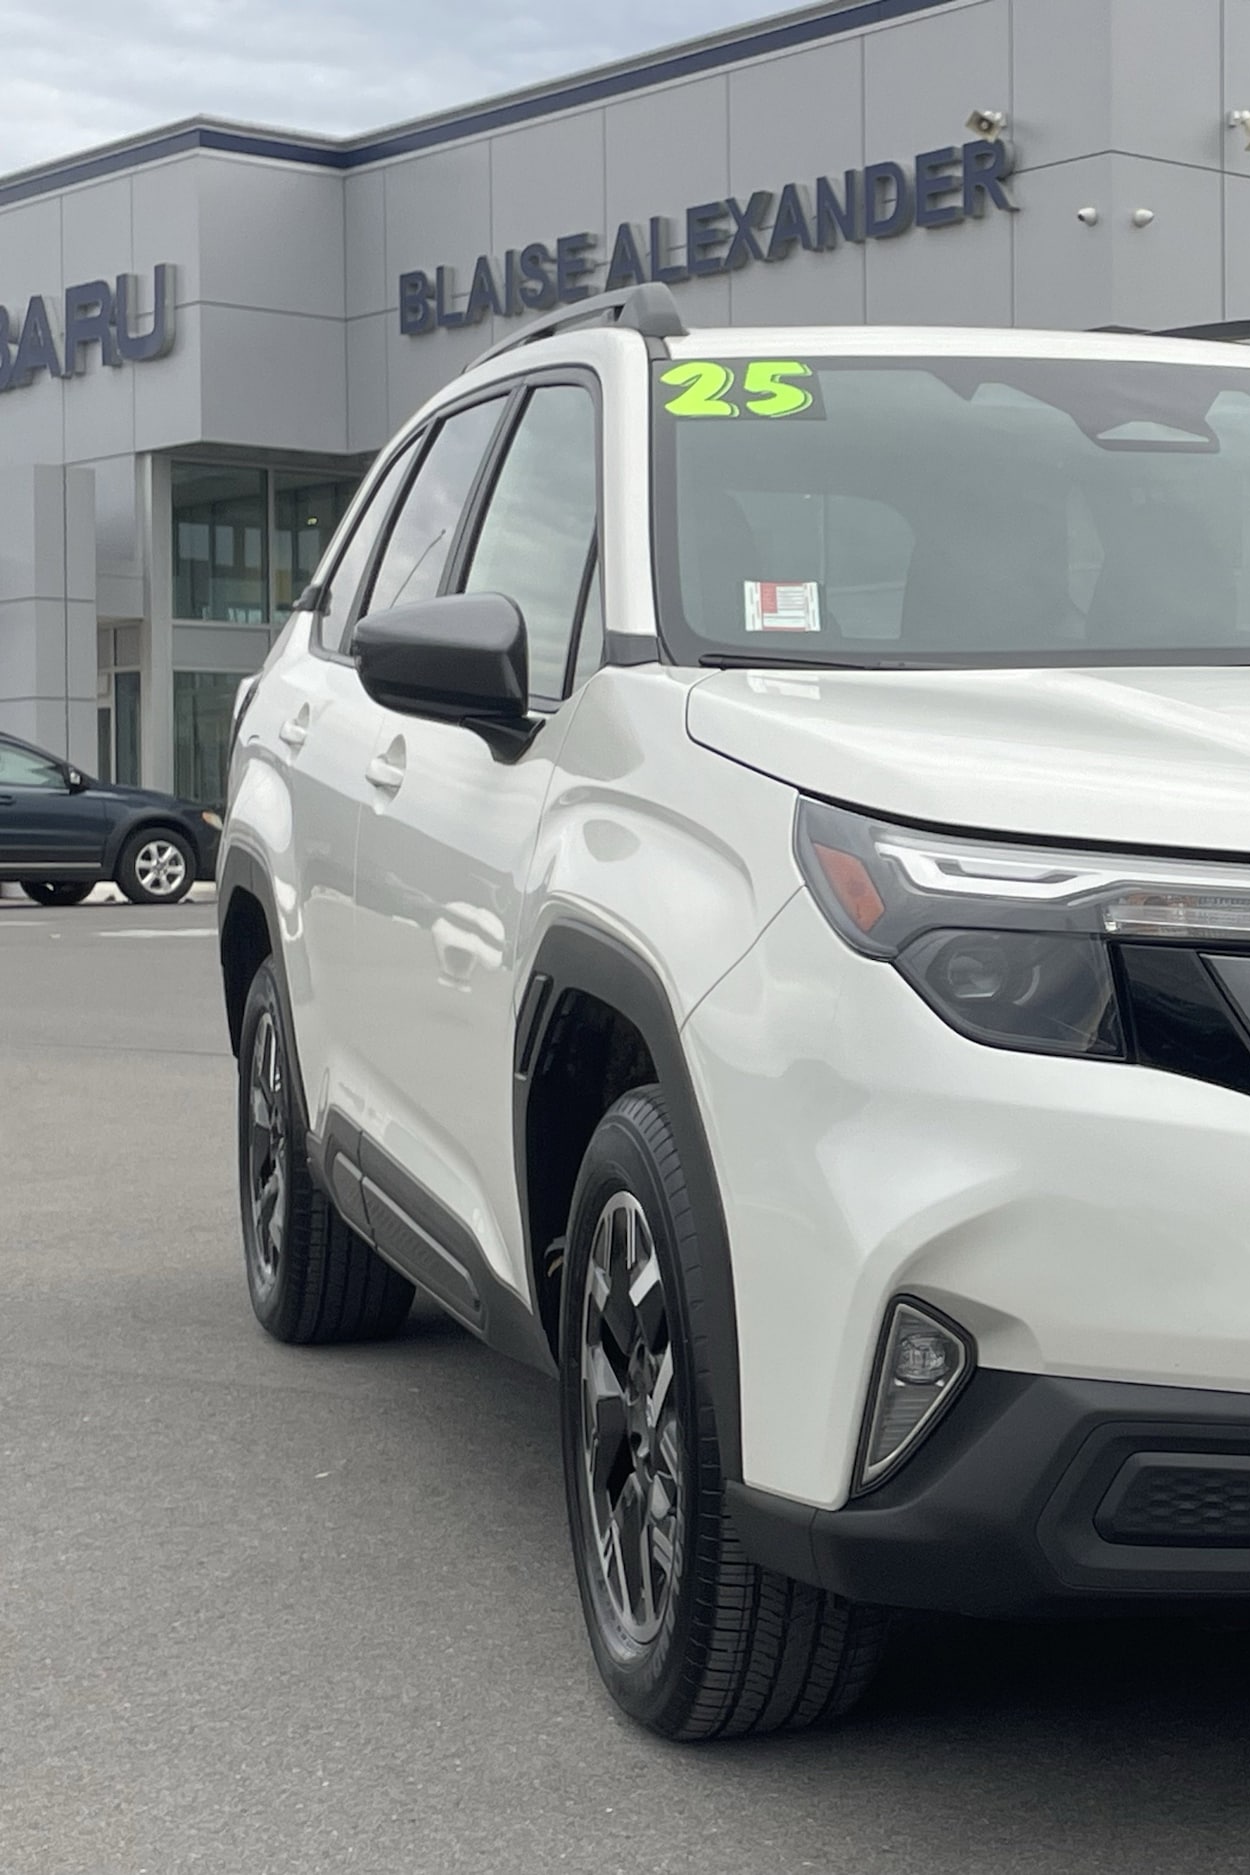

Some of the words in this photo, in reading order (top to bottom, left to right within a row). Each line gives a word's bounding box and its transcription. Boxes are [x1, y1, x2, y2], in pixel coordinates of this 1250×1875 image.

[400, 233, 596, 336] BLAISE
[604, 139, 1020, 292] ALEXANDER
[660, 361, 813, 418] 25
